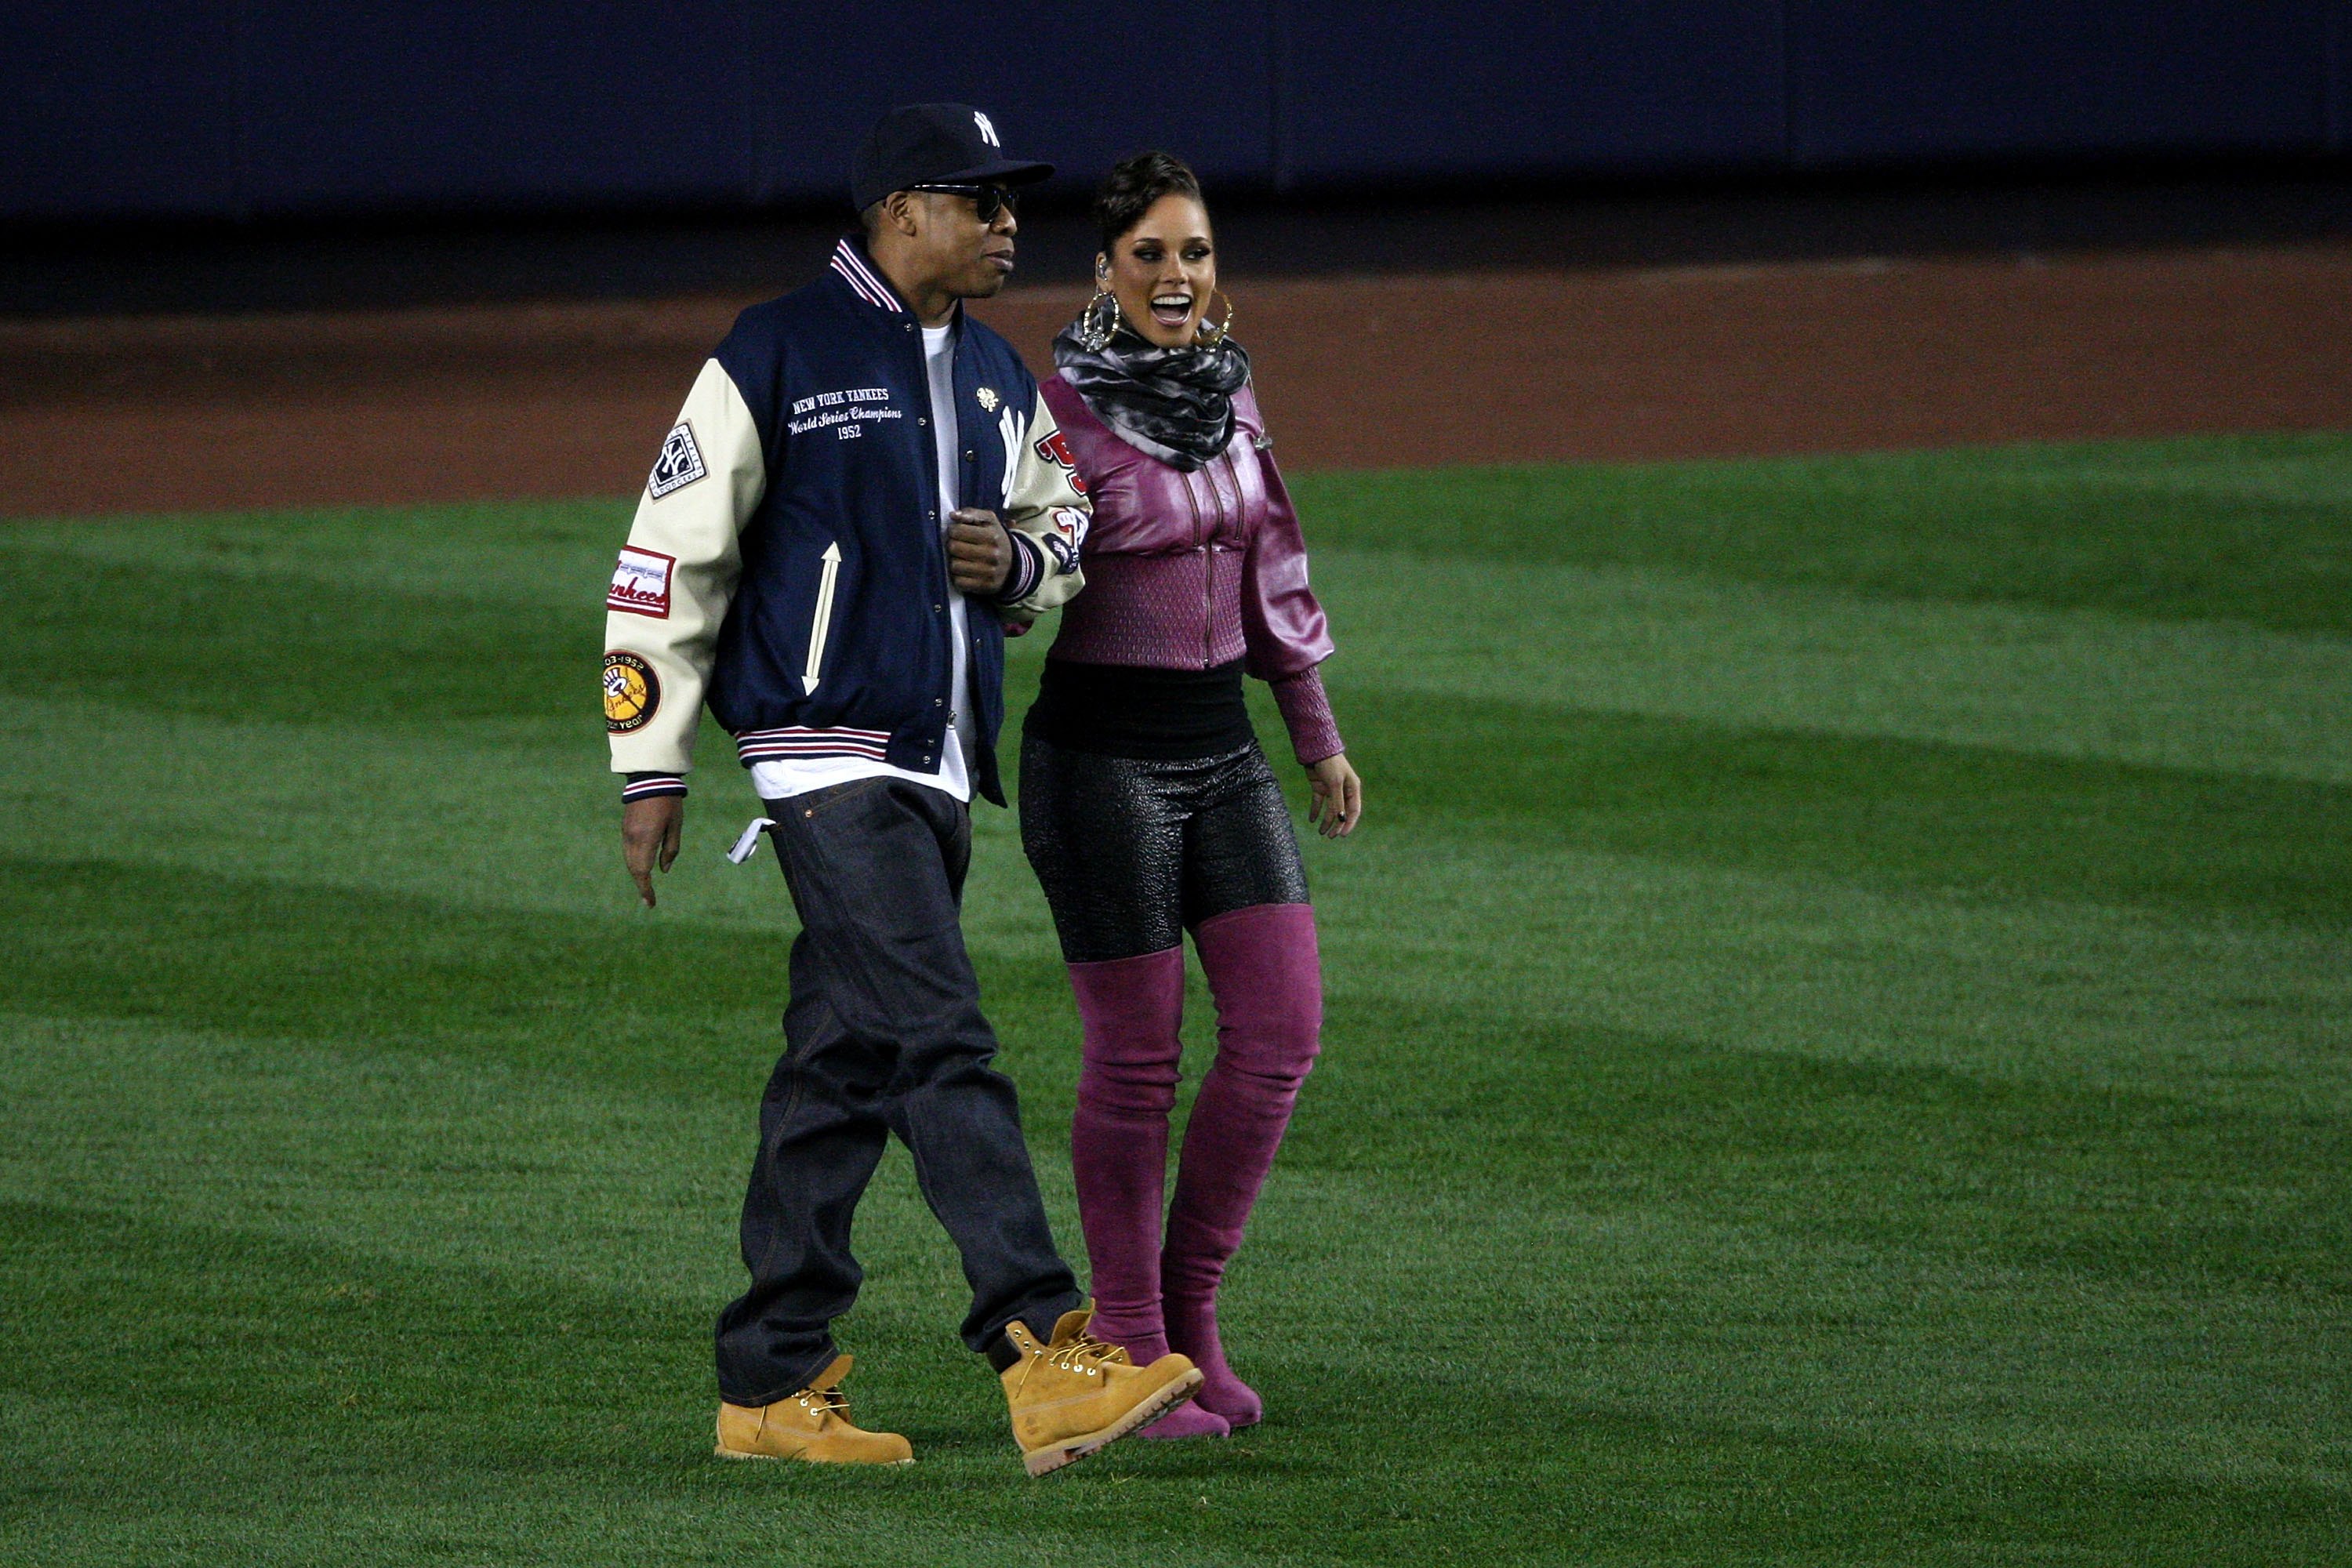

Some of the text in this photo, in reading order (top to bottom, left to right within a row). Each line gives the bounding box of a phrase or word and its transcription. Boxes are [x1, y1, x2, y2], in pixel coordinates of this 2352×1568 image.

[792, 388, 889, 415] NEW YORK YANKEES
[788, 406, 902, 435] World Series Champions
[837, 424, 862, 440] 1952
[604, 655, 644, 671] 03-1952
[619, 714, 643, 729] Year
